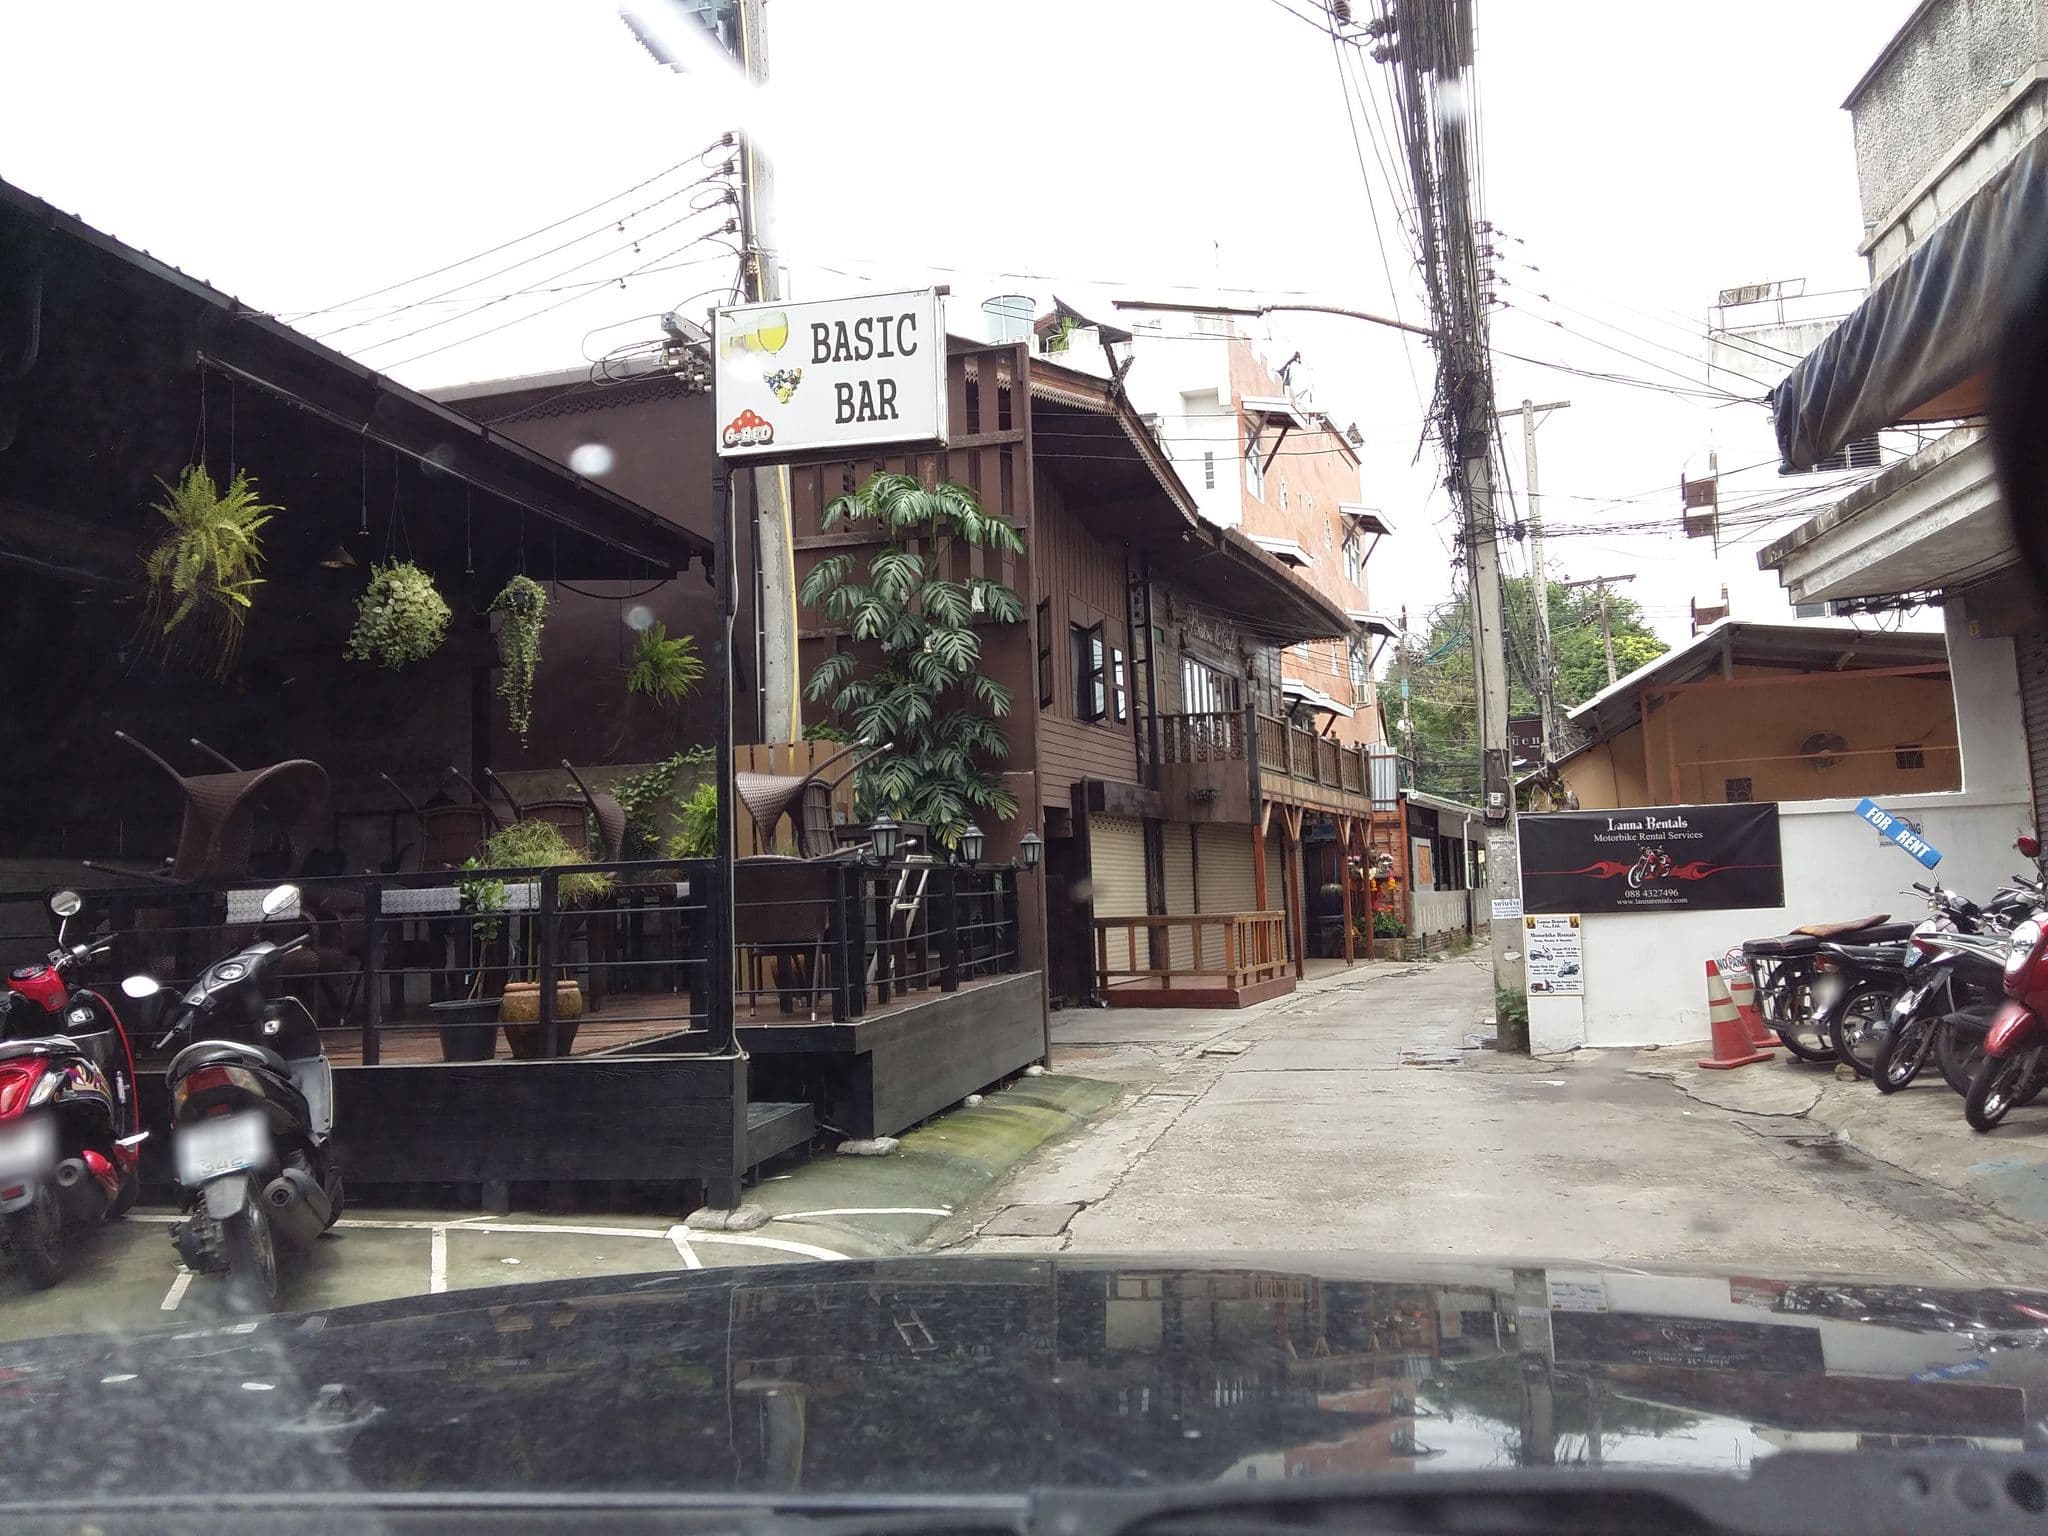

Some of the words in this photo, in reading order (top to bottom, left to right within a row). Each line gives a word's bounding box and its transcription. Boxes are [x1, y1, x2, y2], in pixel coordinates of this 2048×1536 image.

[811, 313, 917, 364] BASIC
[835, 378, 899, 424] BAR
[1593, 833, 1637, 842] Motorbike
[1639, 832, 1666, 841] Rental
[1668, 830, 1704, 839] Services
[1607, 817, 1643, 831] Lanna
[1645, 816, 1688, 830] Rentals
[1865, 806, 1893, 830] FOR
[1895, 829, 1931, 858] RENT
[1625, 889, 1641, 898] 088
[1642, 888, 1679, 898] 4327496
